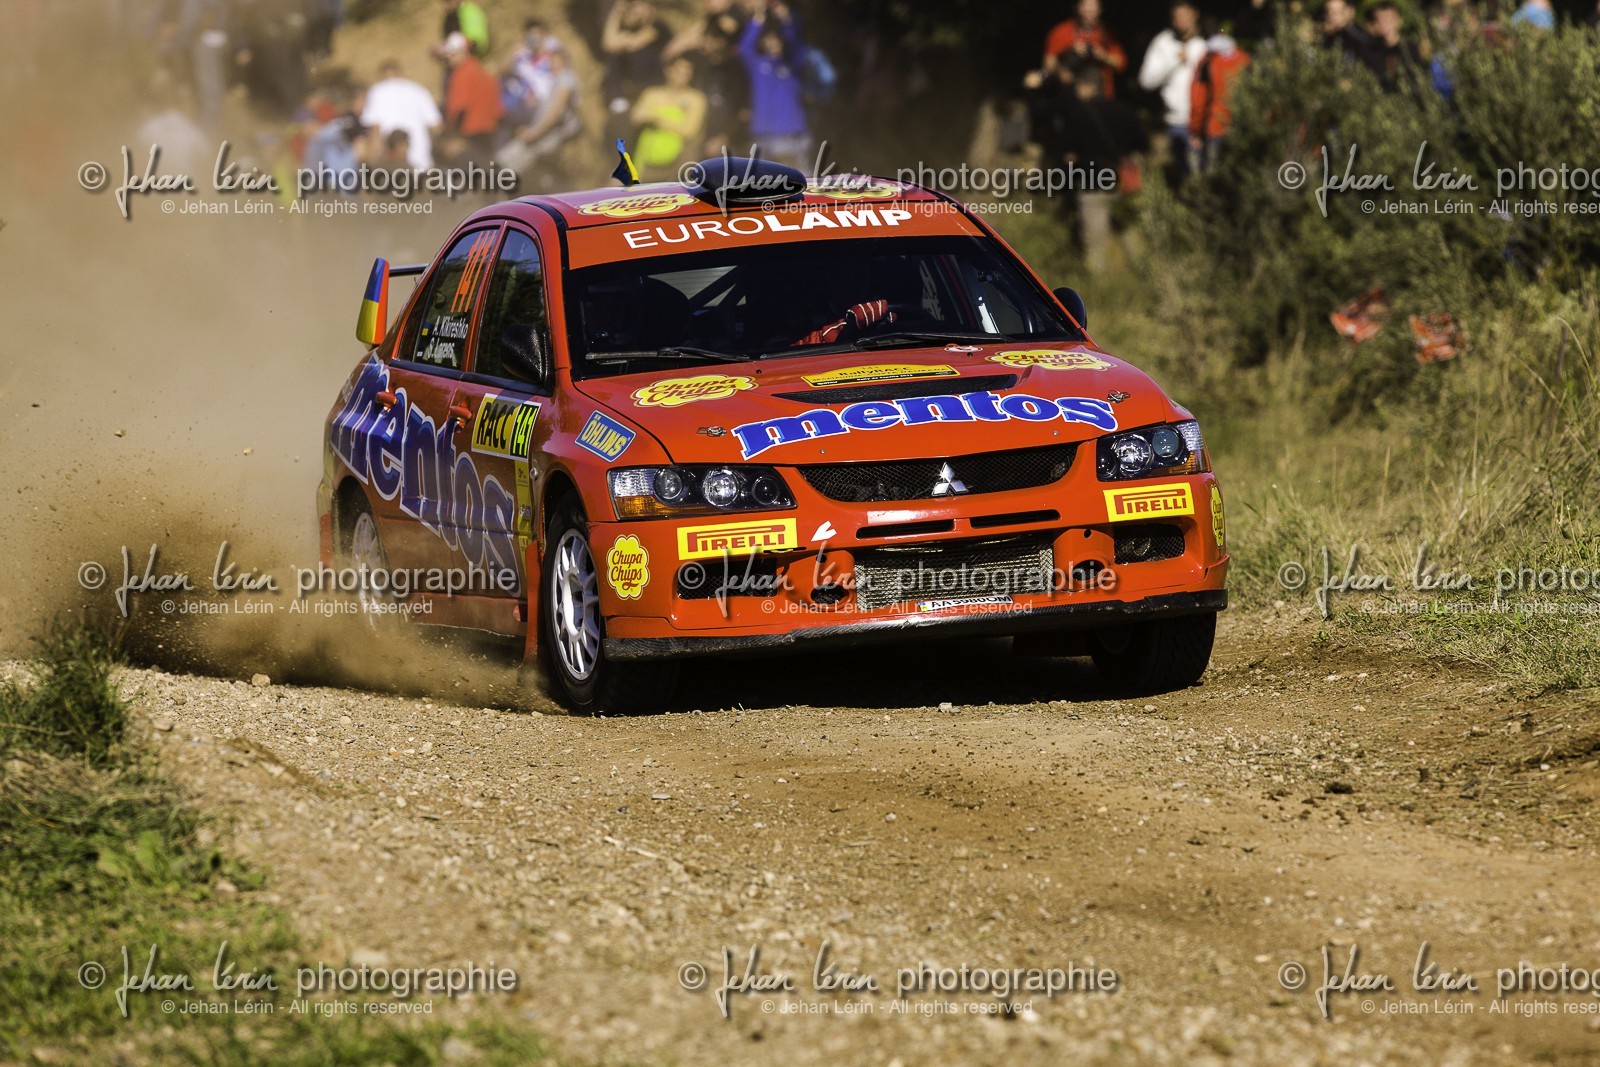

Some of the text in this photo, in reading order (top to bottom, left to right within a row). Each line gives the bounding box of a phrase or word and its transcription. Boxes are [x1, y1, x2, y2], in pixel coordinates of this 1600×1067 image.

[622, 208, 912, 249] EUROLAMP
[646, 384, 737, 403] Chups
[648, 378, 738, 393] Chupa
[476, 402, 517, 450] RACC
[511, 405, 539, 457] 141
[581, 415, 627, 457] ÖHLINS
[731, 391, 1118, 460] mentos
[329, 352, 522, 598] mentos
[1113, 488, 1187, 515] PIRELLI
[686, 524, 786, 553] PIRELLI
[612, 550, 643, 569] Chupa
[610, 565, 643, 591] Chups
